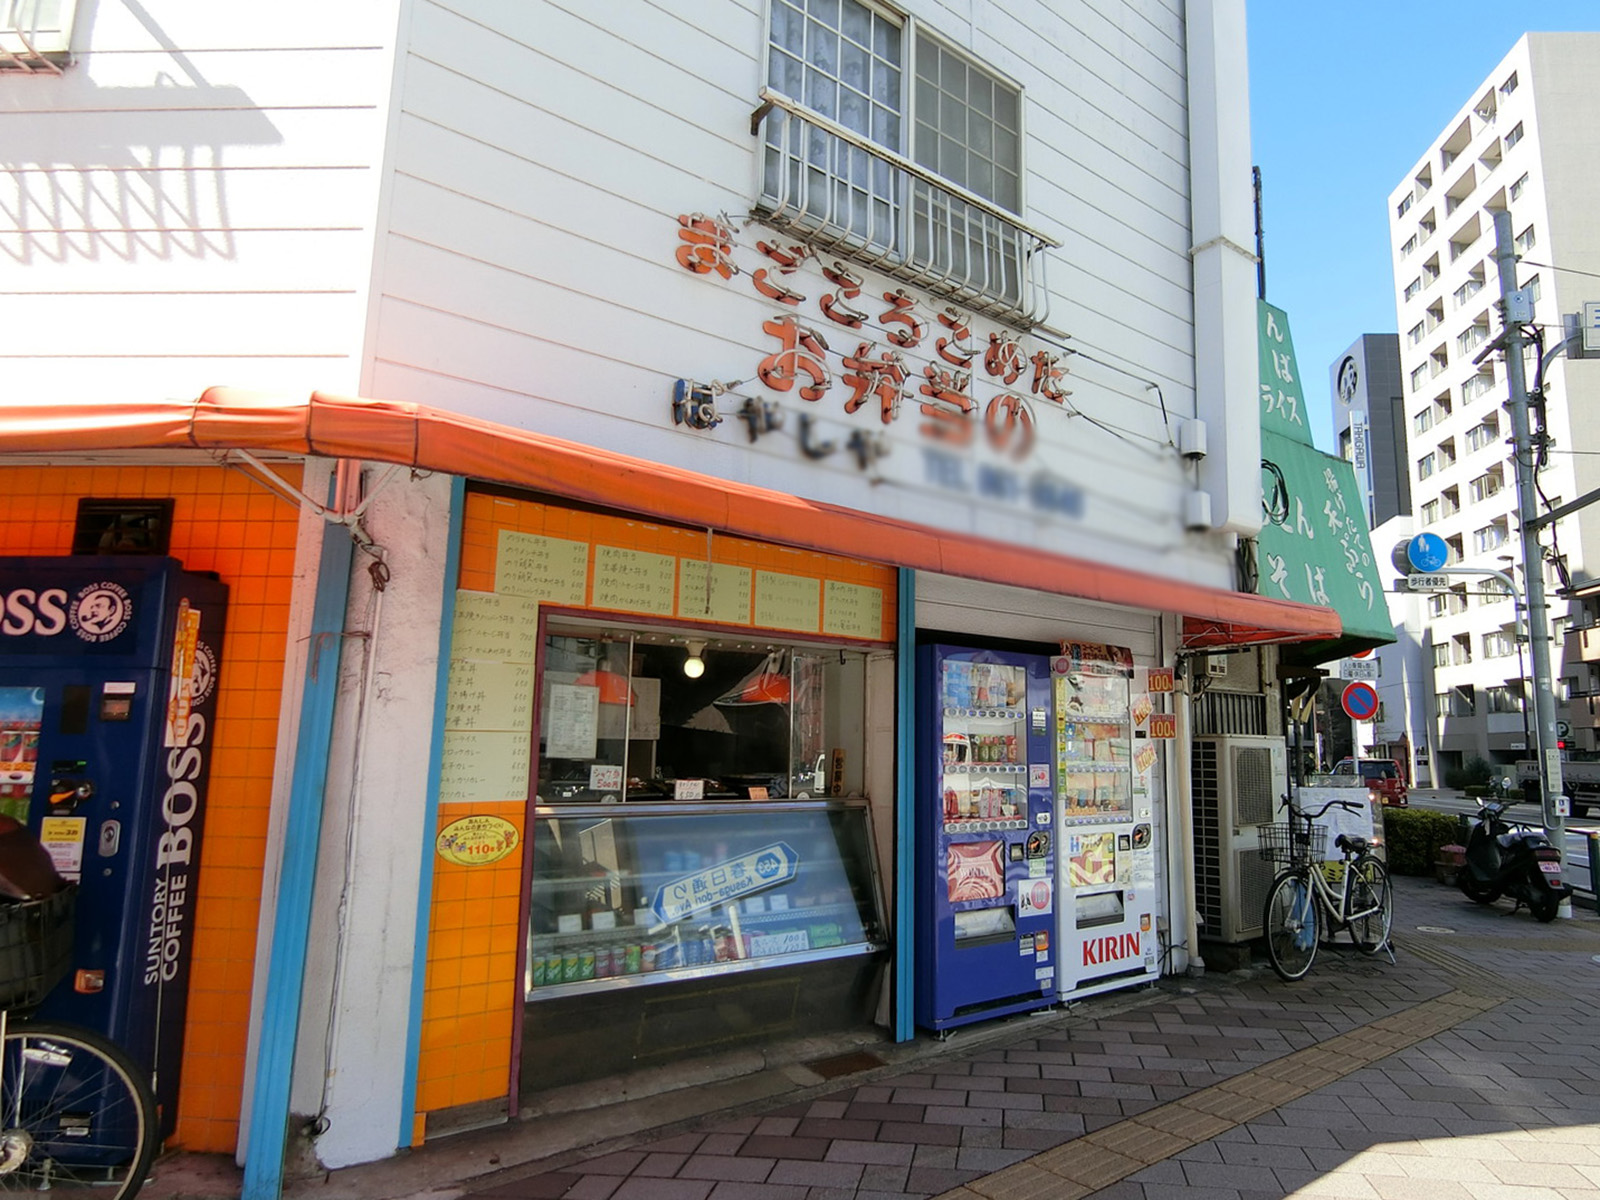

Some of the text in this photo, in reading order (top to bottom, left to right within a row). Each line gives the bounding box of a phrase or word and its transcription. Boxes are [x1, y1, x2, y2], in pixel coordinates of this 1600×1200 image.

[1267, 552, 1331, 606] そば
[1411, 577, 1446, 587] 歩行者優先
[0, 588, 68, 636] SS
[156, 712, 206, 871] BOSS
[144, 878, 167, 985] SUNTORY
[162, 874, 188, 982] COFFEE
[1082, 931, 1140, 967] KIRIN
